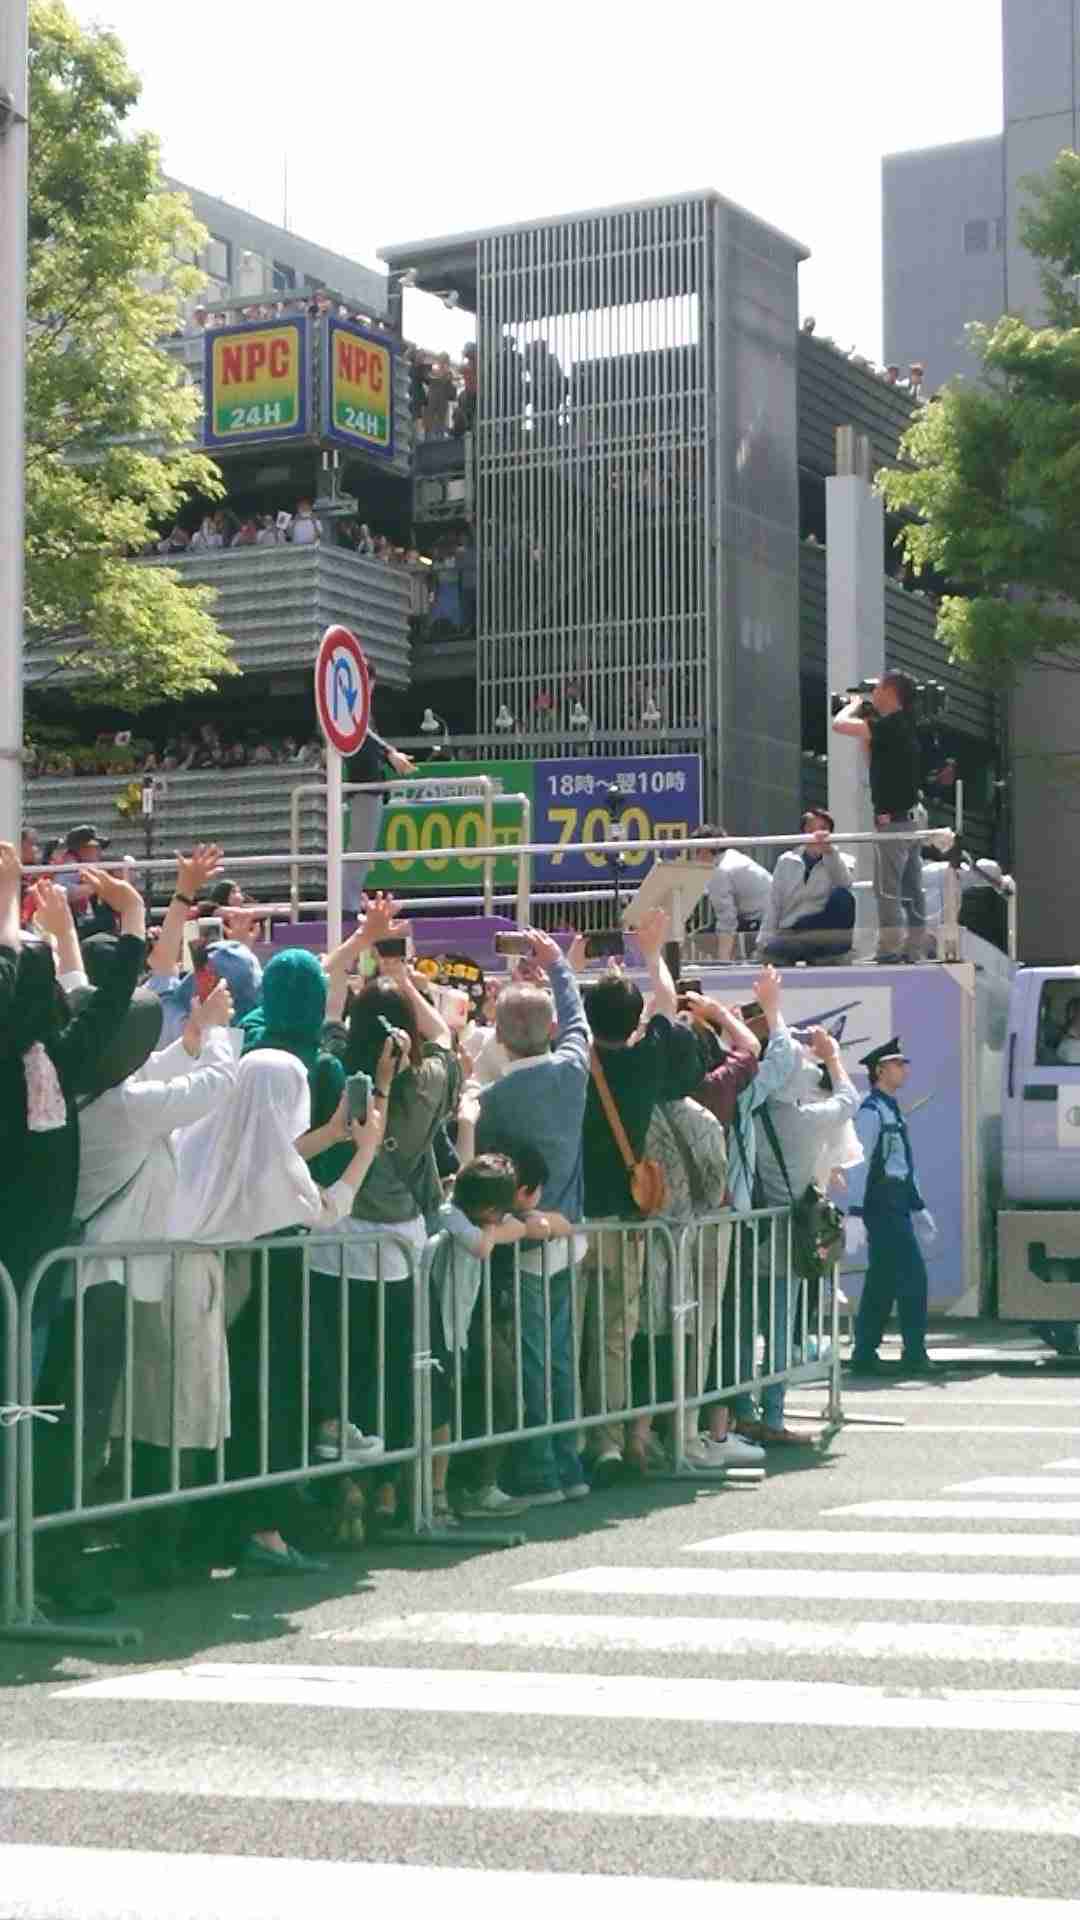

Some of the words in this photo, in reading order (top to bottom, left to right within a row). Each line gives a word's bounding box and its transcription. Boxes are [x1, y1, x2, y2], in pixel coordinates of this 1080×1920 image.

[221, 338, 290, 385] NPC
[336, 340, 383, 393] NPC
[230, 401, 282, 428] 24H
[343, 406, 378, 436] 24H
